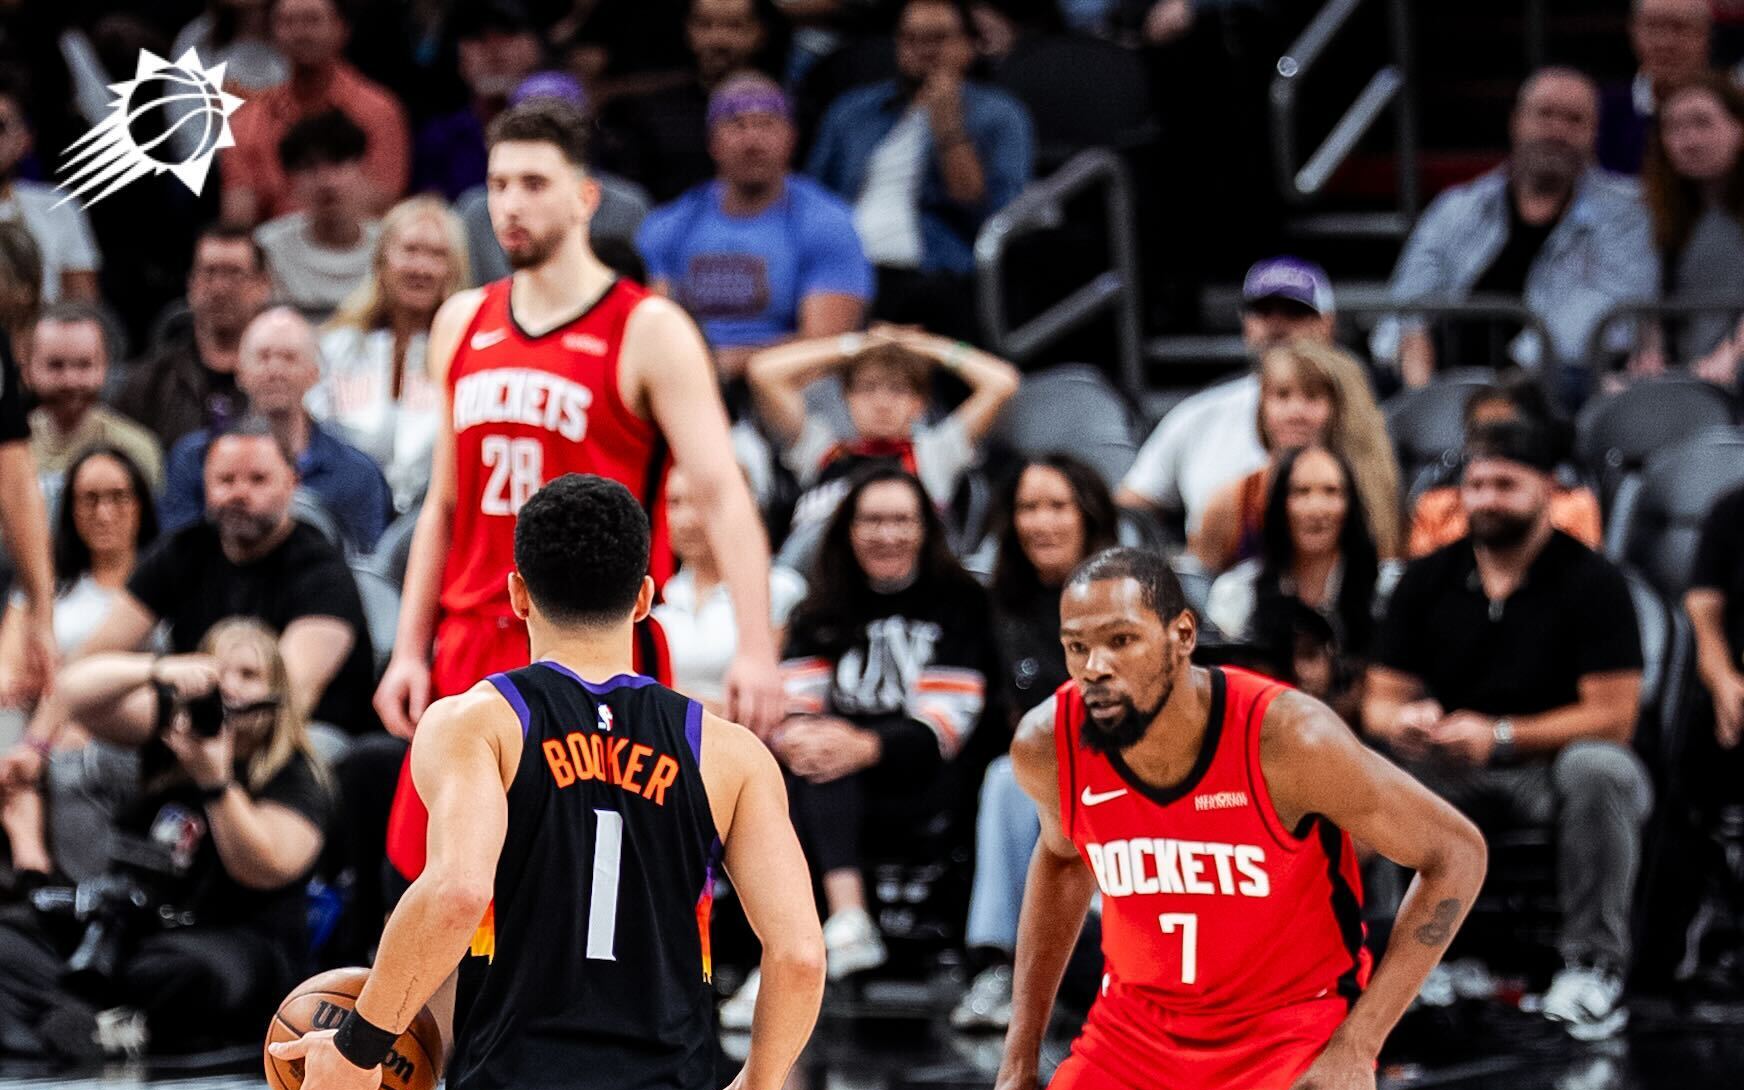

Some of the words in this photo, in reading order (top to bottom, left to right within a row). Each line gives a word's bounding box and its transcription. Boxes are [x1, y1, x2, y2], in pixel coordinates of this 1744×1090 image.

[481, 435, 543, 516] 28
[542, 732, 679, 806] BOOKER
[586, 808, 623, 961] 1
[1086, 838, 1270, 897] ROCKETS
[1159, 913, 1198, 984] 7
[312, 1000, 415, 1085] Won
